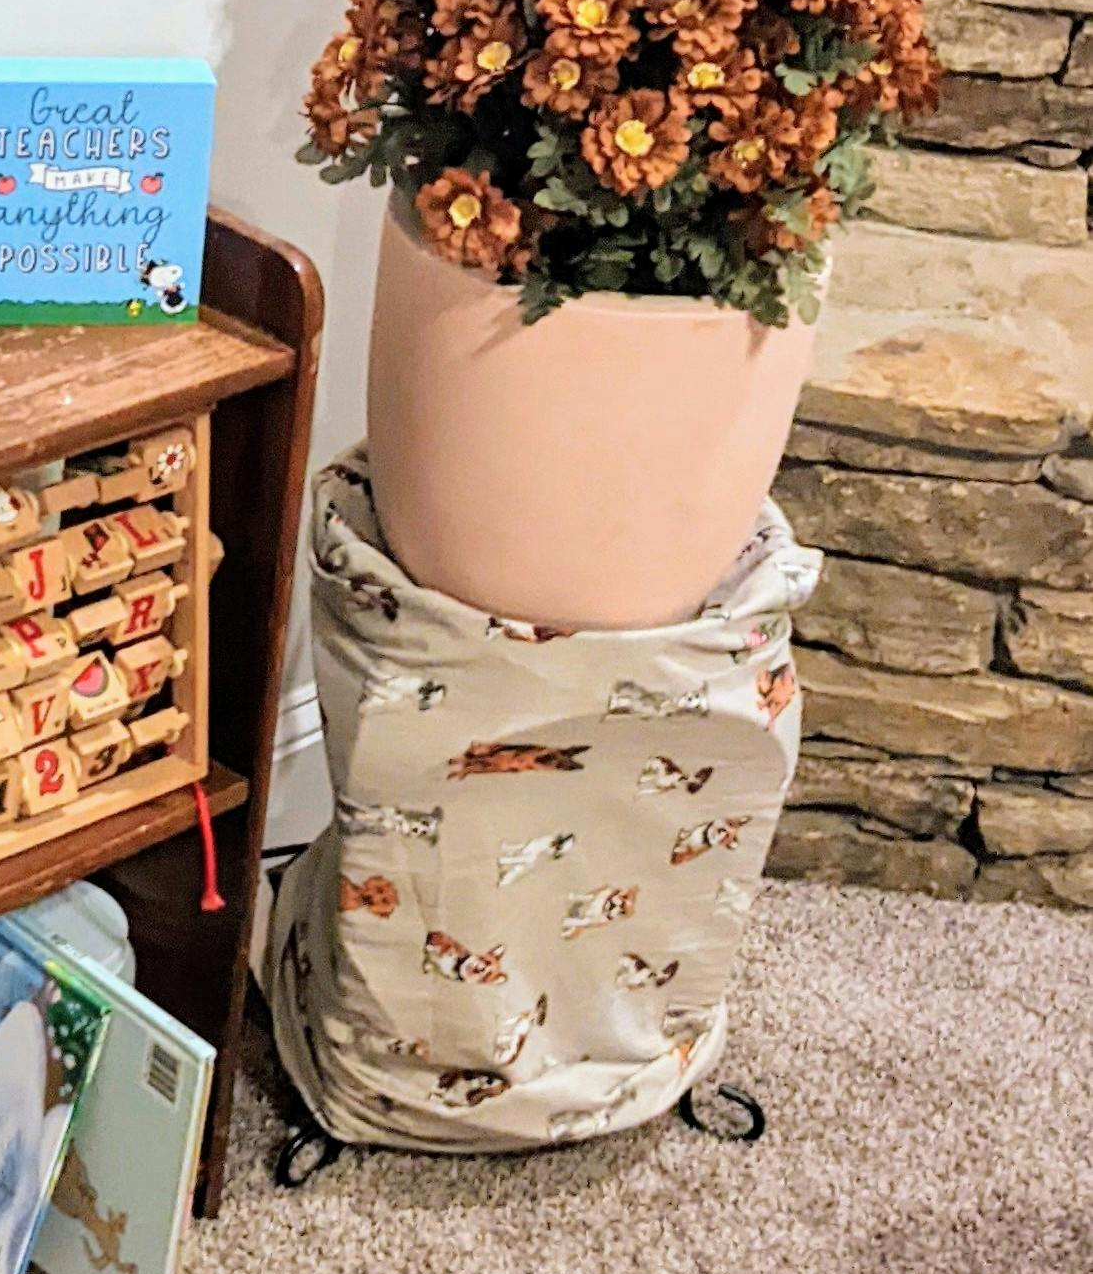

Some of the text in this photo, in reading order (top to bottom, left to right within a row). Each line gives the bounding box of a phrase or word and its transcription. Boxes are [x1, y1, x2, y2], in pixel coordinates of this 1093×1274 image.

[29, 86, 140, 126] Great
[55, 172, 110, 187] MAKE
[114, 513, 160, 548] L
[28, 549, 44, 601] J
[123, 595, 155, 634] R
[10, 617, 46, 658] P
[32, 694, 56, 735] V
[35, 749, 65, 796] 2
